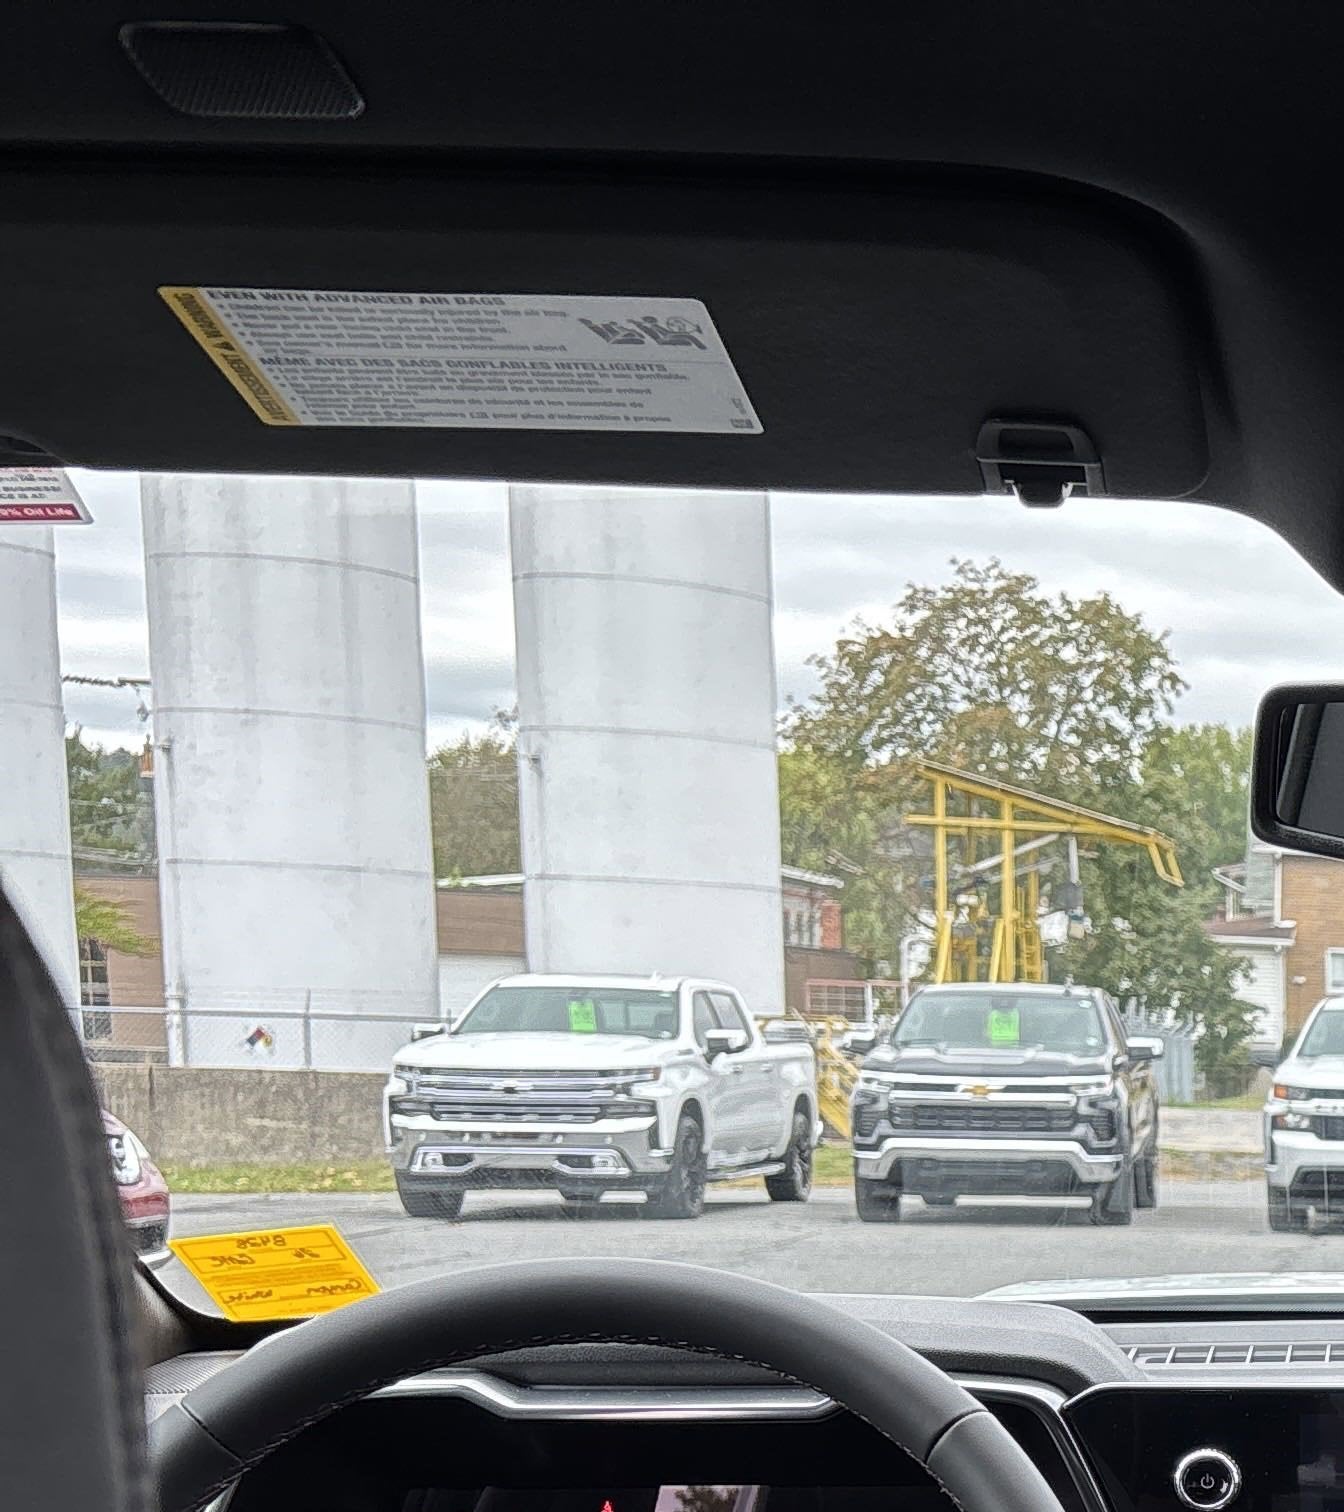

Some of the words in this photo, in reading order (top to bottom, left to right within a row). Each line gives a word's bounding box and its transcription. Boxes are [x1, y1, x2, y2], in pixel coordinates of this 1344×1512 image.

[207, 290, 255, 300] EVEN
[260, 291, 307, 301] WITH
[314, 293, 413, 304] ADVANCED
[419, 296, 448, 305] AIR
[454, 296, 505, 305] BAGS
[315, 358, 358, 367] AVEC
[361, 358, 396, 367] DES
[400, 359, 442, 368] SACS
[447, 360, 551, 370] GONFLABLES
[555, 362, 668, 372] INTELLIGENTS
